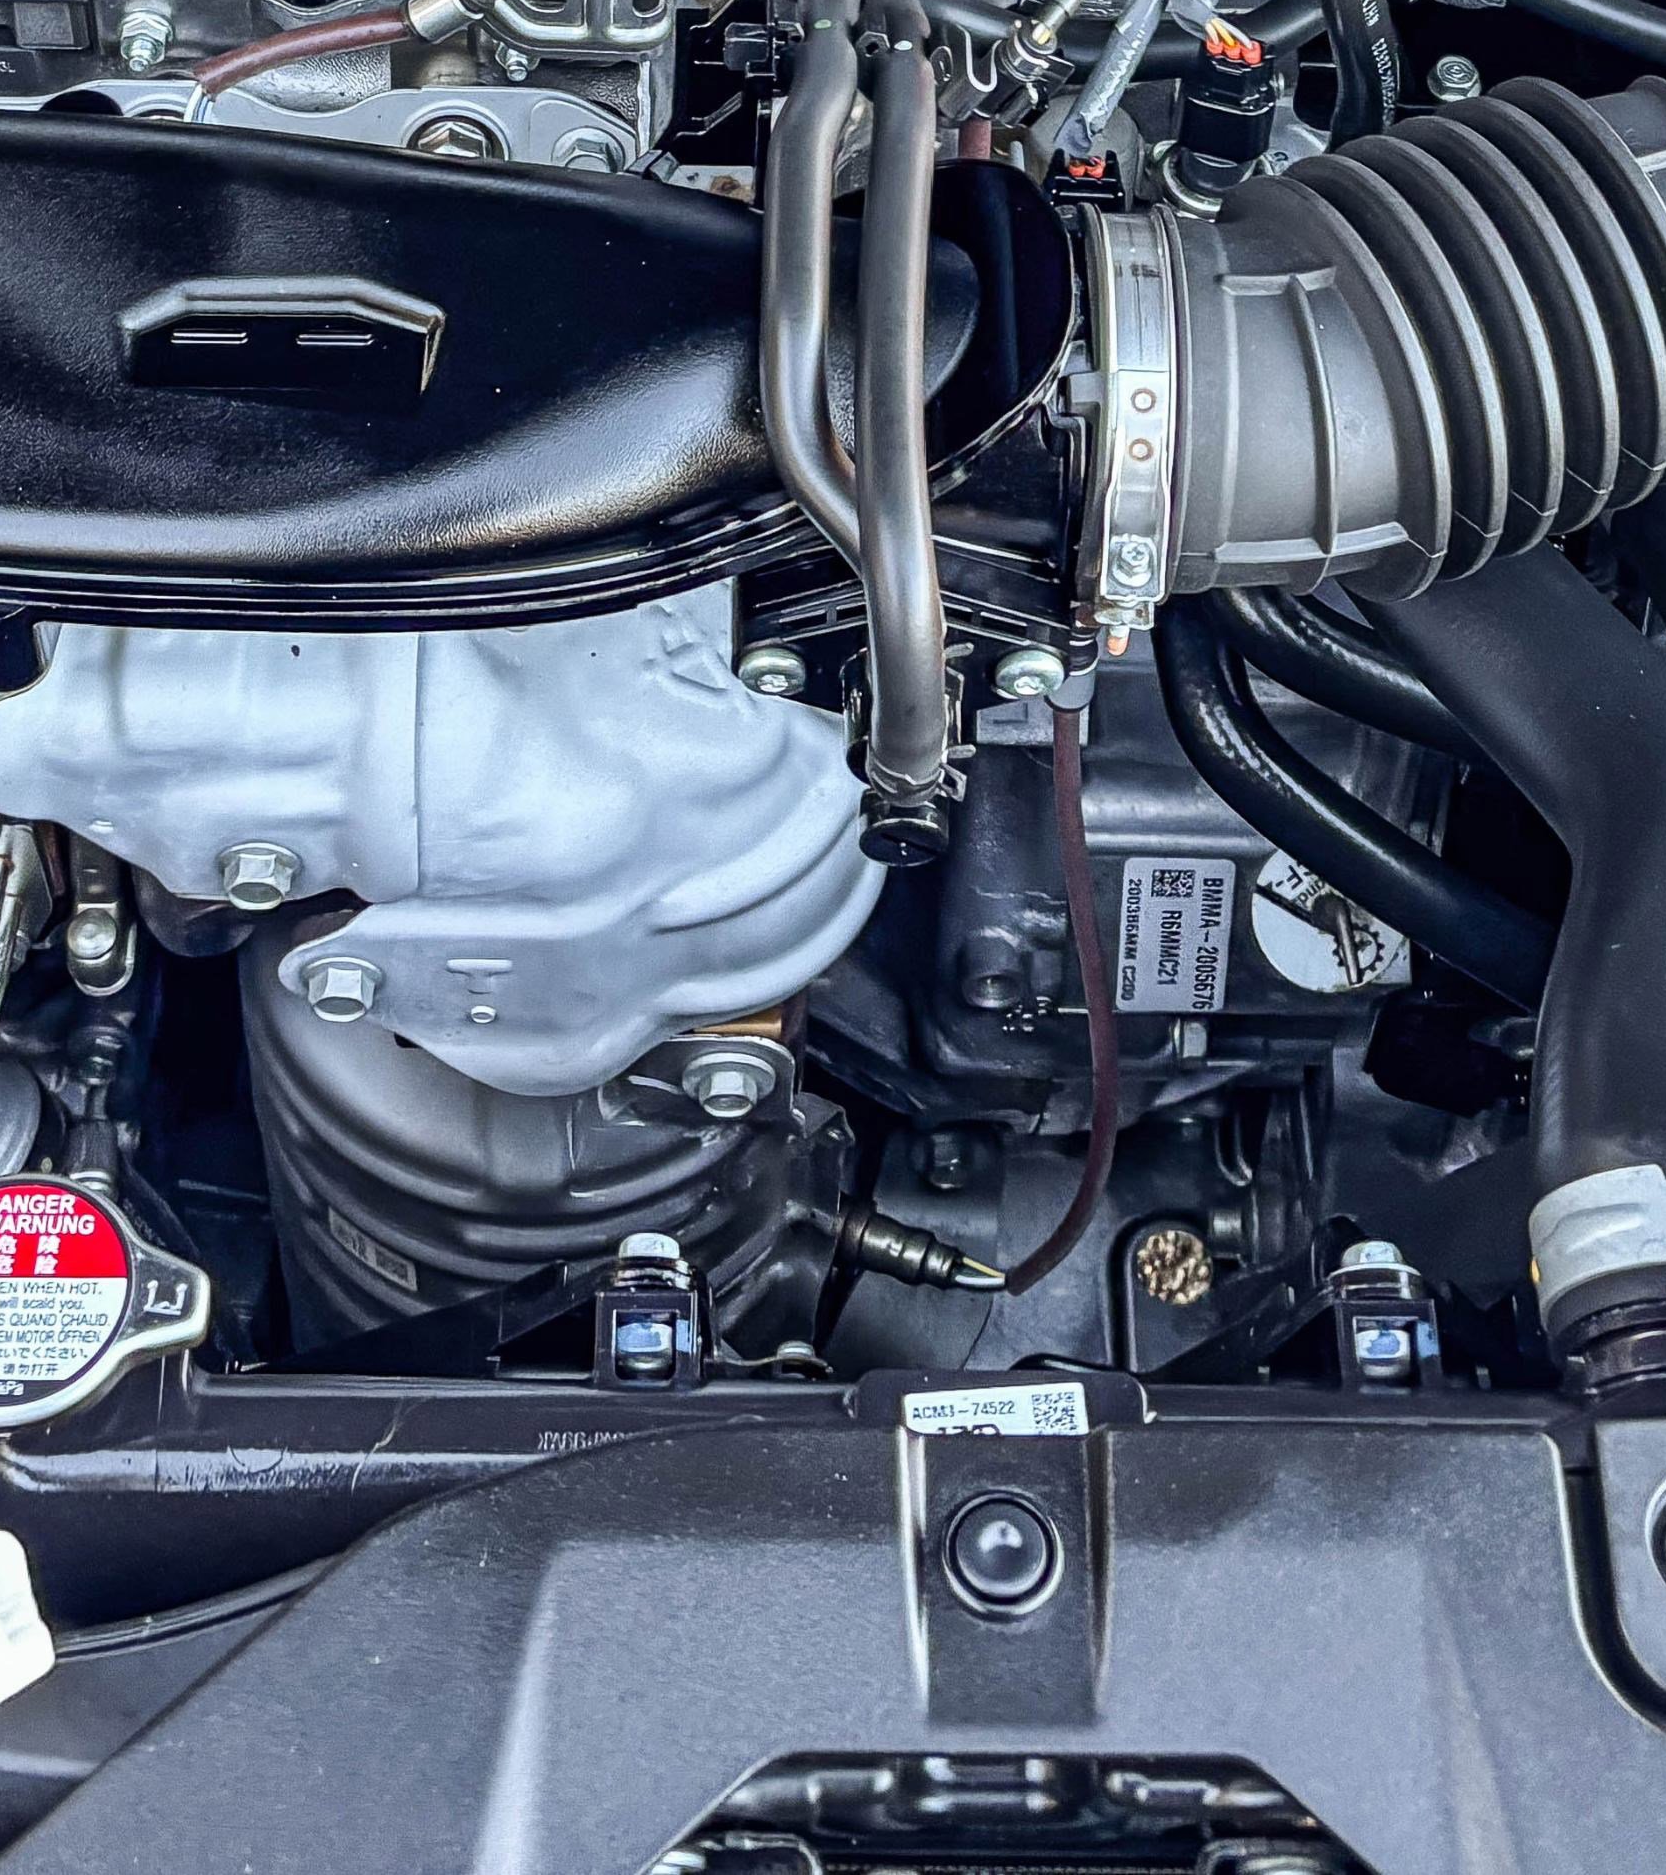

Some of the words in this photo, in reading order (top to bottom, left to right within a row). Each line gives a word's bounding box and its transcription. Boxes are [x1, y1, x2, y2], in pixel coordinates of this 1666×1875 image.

[23, 1282, 64, 1295] WHEN
[69, 1282, 102, 1295] HOT.
[0, 1297, 19, 1309] will
[22, 1297, 55, 1309] scald
[59, 1300, 85, 1313] you.
[10, 1313, 57, 1326] QUAND
[16, 1330, 55, 1343] MOTOR
